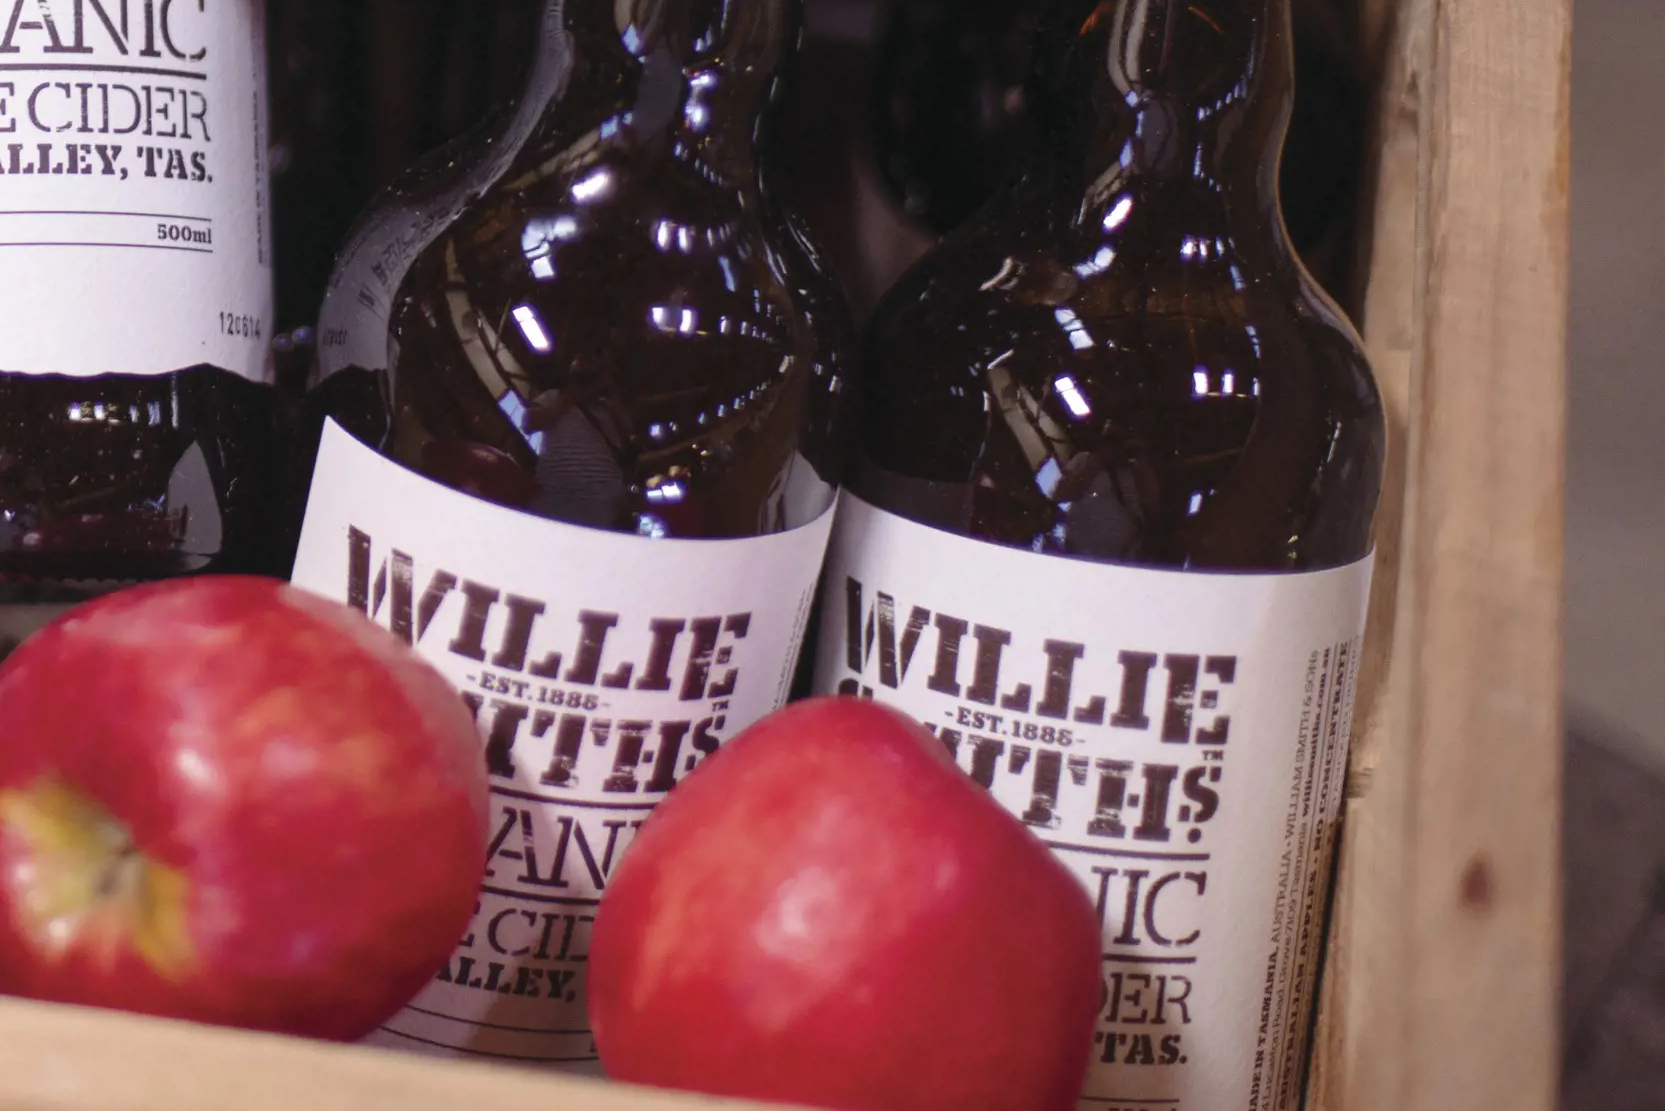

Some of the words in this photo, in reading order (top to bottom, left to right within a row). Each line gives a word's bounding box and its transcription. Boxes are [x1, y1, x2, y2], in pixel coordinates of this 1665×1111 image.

[27, 81, 212, 143] CIDER
[137, 147, 214, 183] TAS.
[157, 224, 212, 245] 500ml
[347, 524, 752, 701] WILLIE
[847, 576, 1237, 745] WILLIE
[1254, 1049, 1264, 1070] IN
